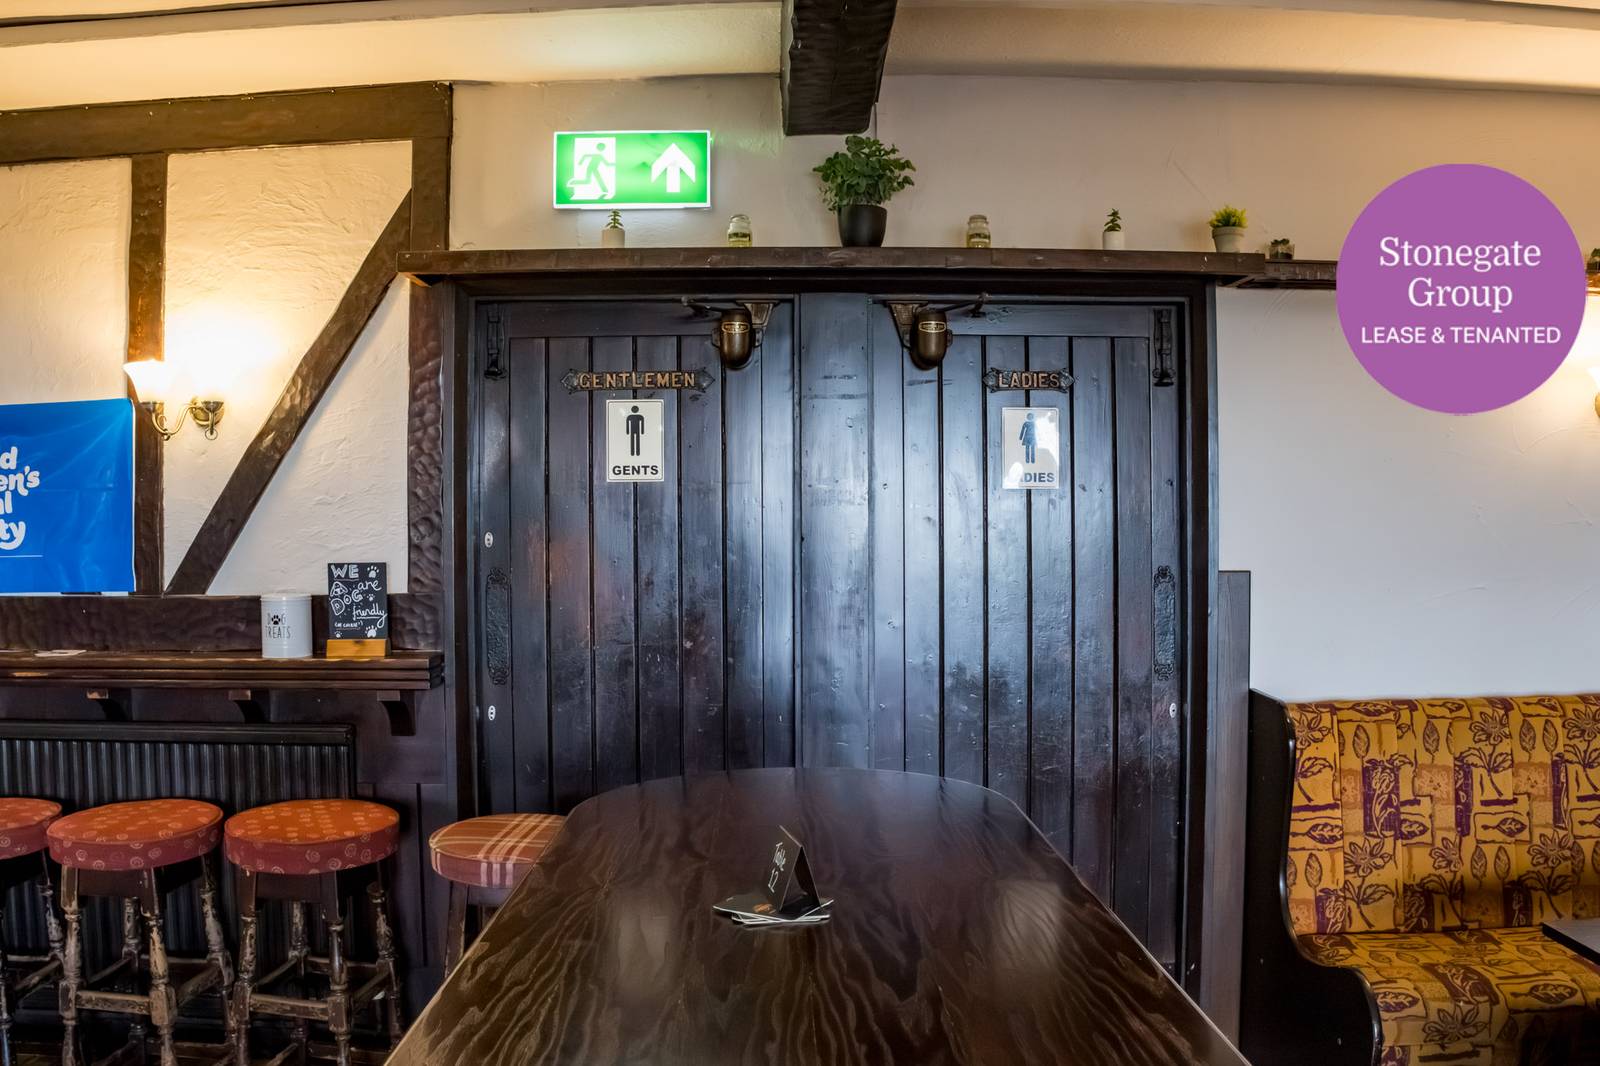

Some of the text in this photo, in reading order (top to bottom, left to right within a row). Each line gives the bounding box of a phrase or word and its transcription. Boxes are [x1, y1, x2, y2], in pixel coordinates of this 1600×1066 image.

[579, 372, 695, 388] GENTLEMEN
[998, 372, 1060, 388] LADIES
[612, 465, 659, 476] GENTS
[1020, 472, 1055, 483] DIES
[330, 564, 359, 579] WE
[358, 580, 382, 592] are
[352, 603, 387, 628] friendly
